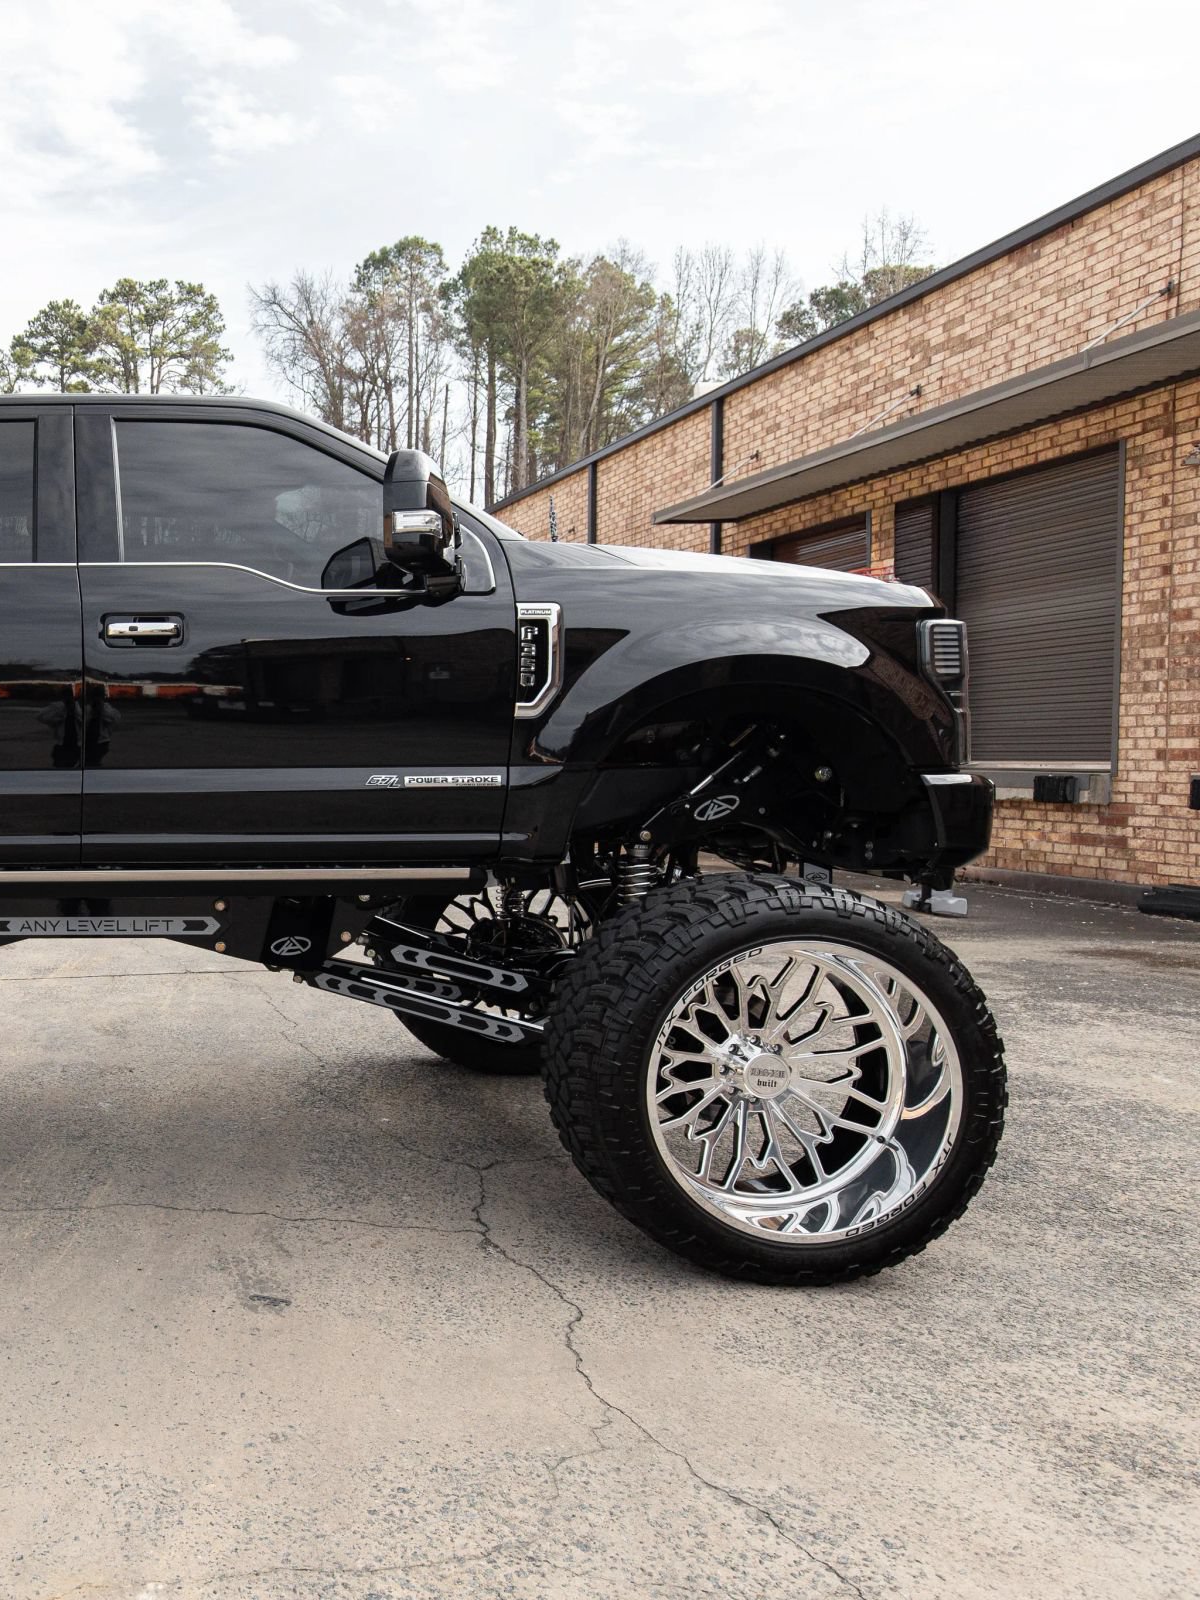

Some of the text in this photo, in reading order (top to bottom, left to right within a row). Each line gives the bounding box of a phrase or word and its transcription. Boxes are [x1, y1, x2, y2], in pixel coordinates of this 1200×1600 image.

[19, 920, 174, 932] ANY LEVEL LIFT
[657, 948, 763, 1053] JTX FORGED
[845, 1132, 953, 1237] JTX FORGED
